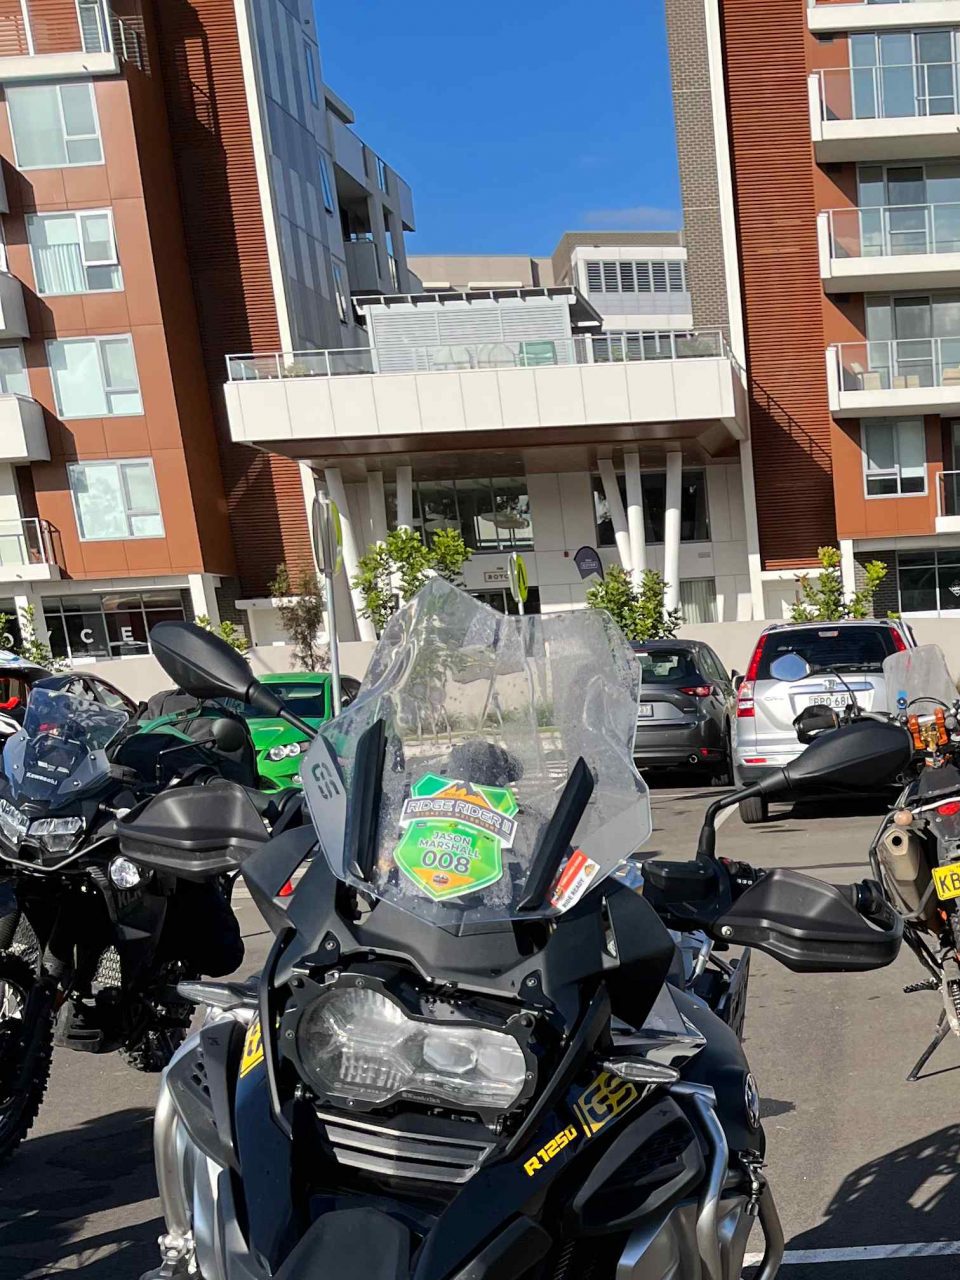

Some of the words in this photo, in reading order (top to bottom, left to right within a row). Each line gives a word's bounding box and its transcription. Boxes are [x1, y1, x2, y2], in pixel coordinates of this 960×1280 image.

[311, 762, 340, 800] GS
[406, 799, 455, 813] RIDGE
[455, 800, 502, 828] RIDER
[419, 840, 481, 859] MARSHALL
[432, 831, 472, 846] JASON
[422, 850, 470, 875] 008
[523, 1156, 543, 1177] R
[537, 1124, 578, 1163] 1250
